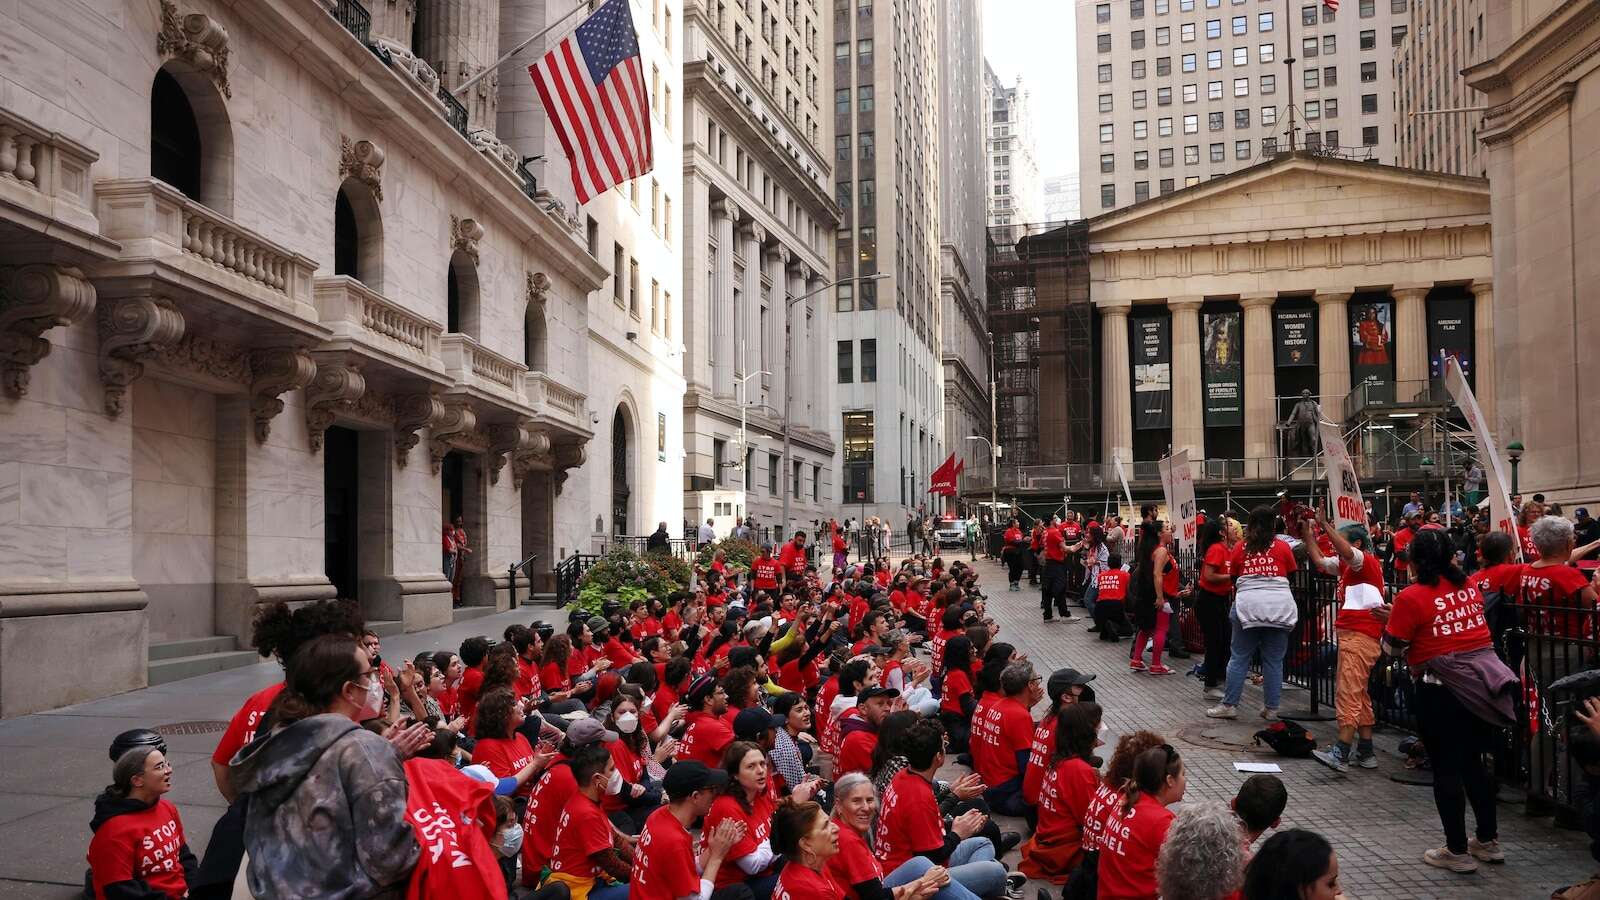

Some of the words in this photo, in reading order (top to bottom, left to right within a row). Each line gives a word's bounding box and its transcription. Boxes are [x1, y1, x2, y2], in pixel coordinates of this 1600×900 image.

[1243, 565, 1279, 574] ARMING
[1245, 557, 1274, 567] STOP
[1434, 587, 1476, 611] STOP
[142, 819, 177, 850] STOP
